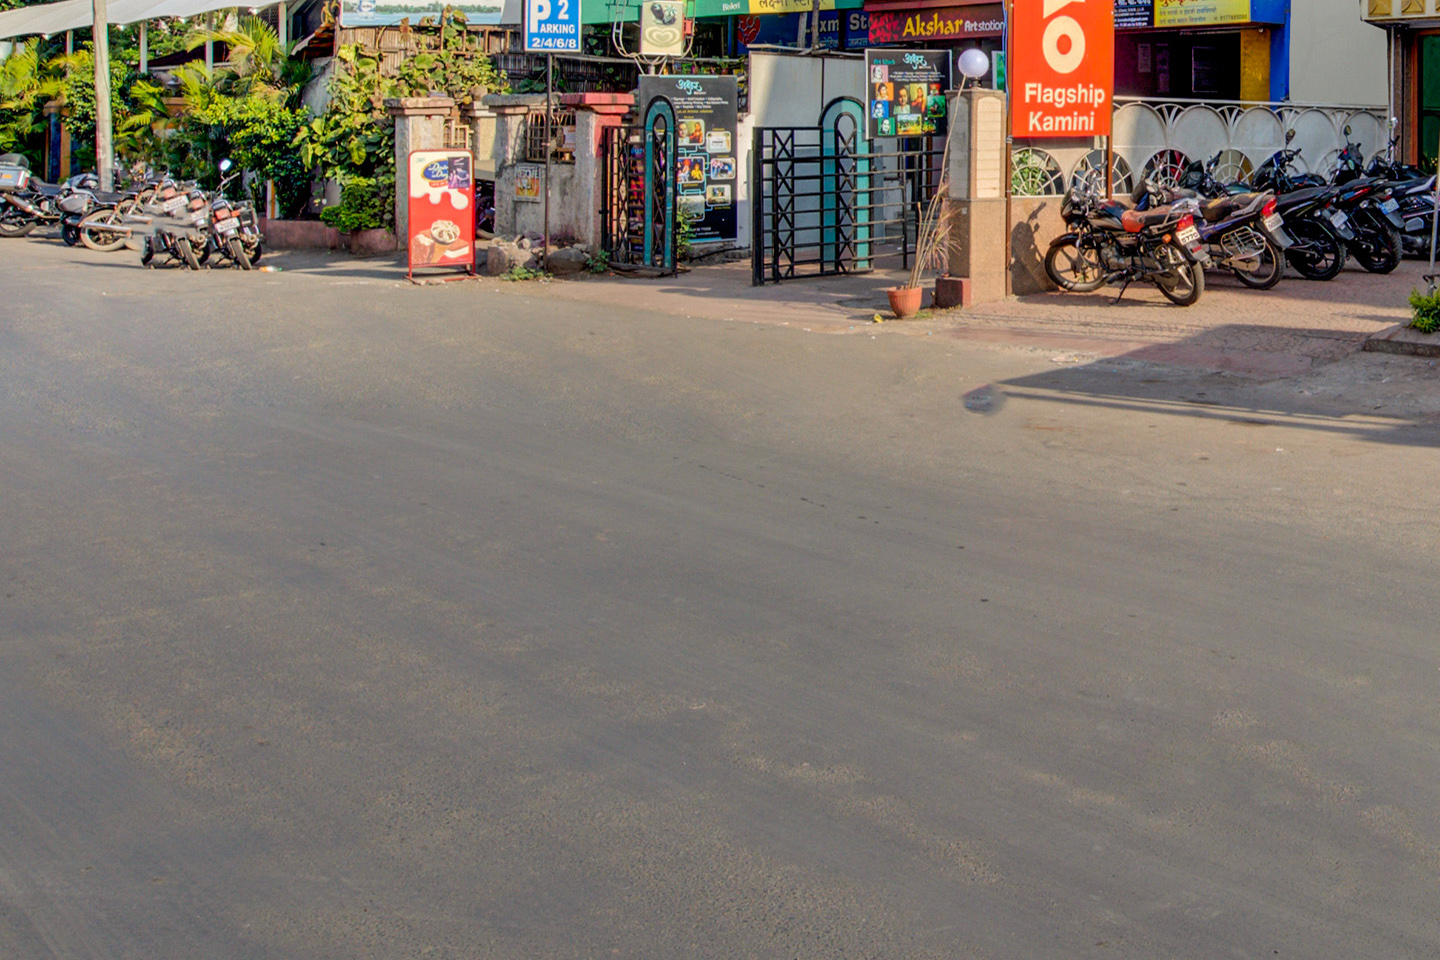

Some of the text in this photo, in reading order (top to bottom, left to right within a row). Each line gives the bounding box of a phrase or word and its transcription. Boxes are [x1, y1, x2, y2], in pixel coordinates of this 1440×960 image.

[902, 12, 963, 37] Akshar
[531, 37, 577, 49] 2/4/6/8
[1025, 83, 1105, 108] Flagship
[1028, 111, 1095, 131] Kamini
